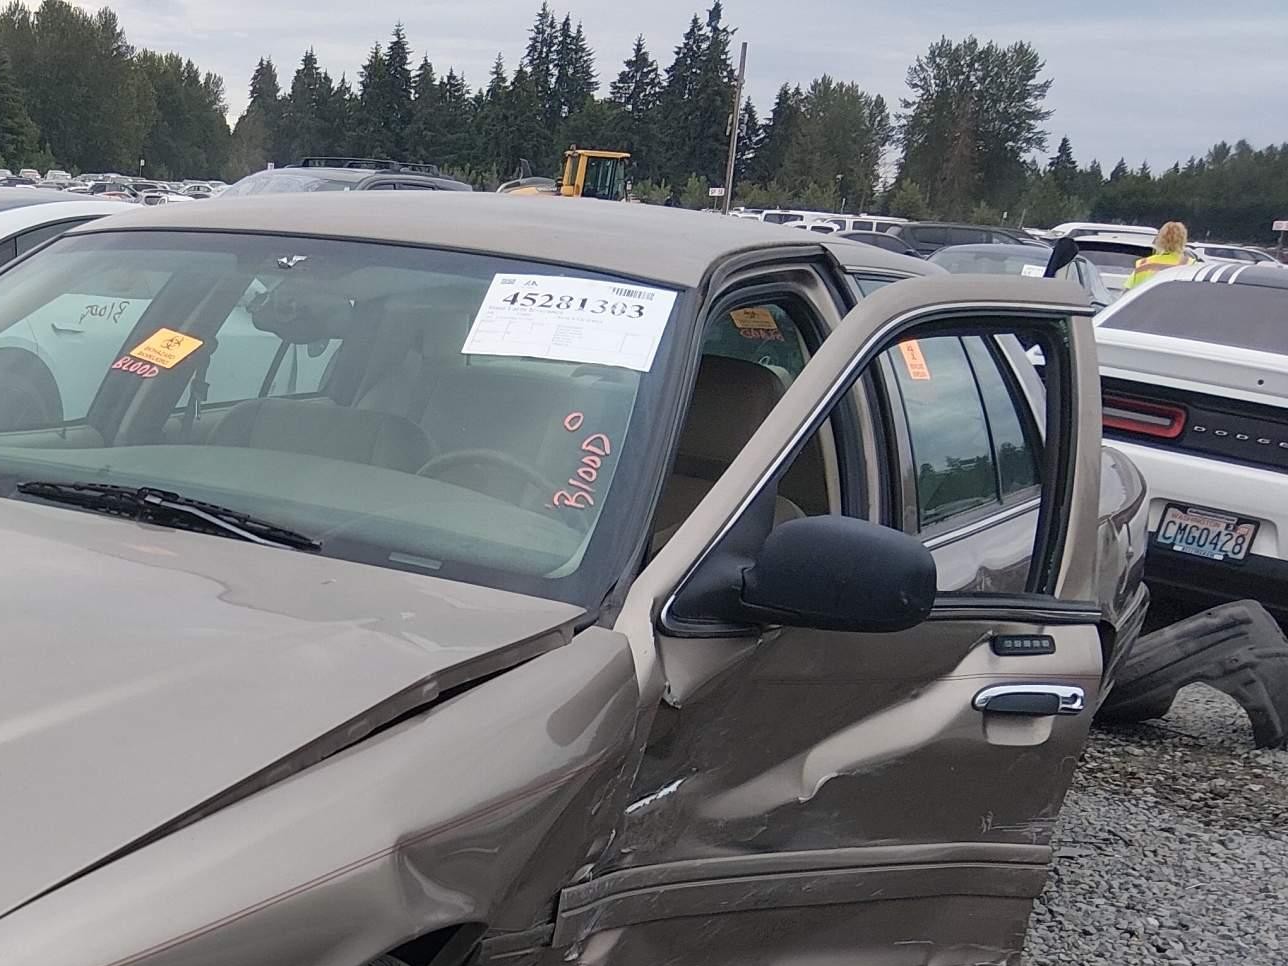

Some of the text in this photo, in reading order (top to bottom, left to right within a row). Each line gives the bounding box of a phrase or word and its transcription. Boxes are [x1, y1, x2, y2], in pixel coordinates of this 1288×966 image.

[502, 291, 646, 319] 45281303
[111, 355, 160, 378] BLOOD
[1193, 425, 1288, 449] DODGE
[1162, 520, 1247, 556] CMG0428
